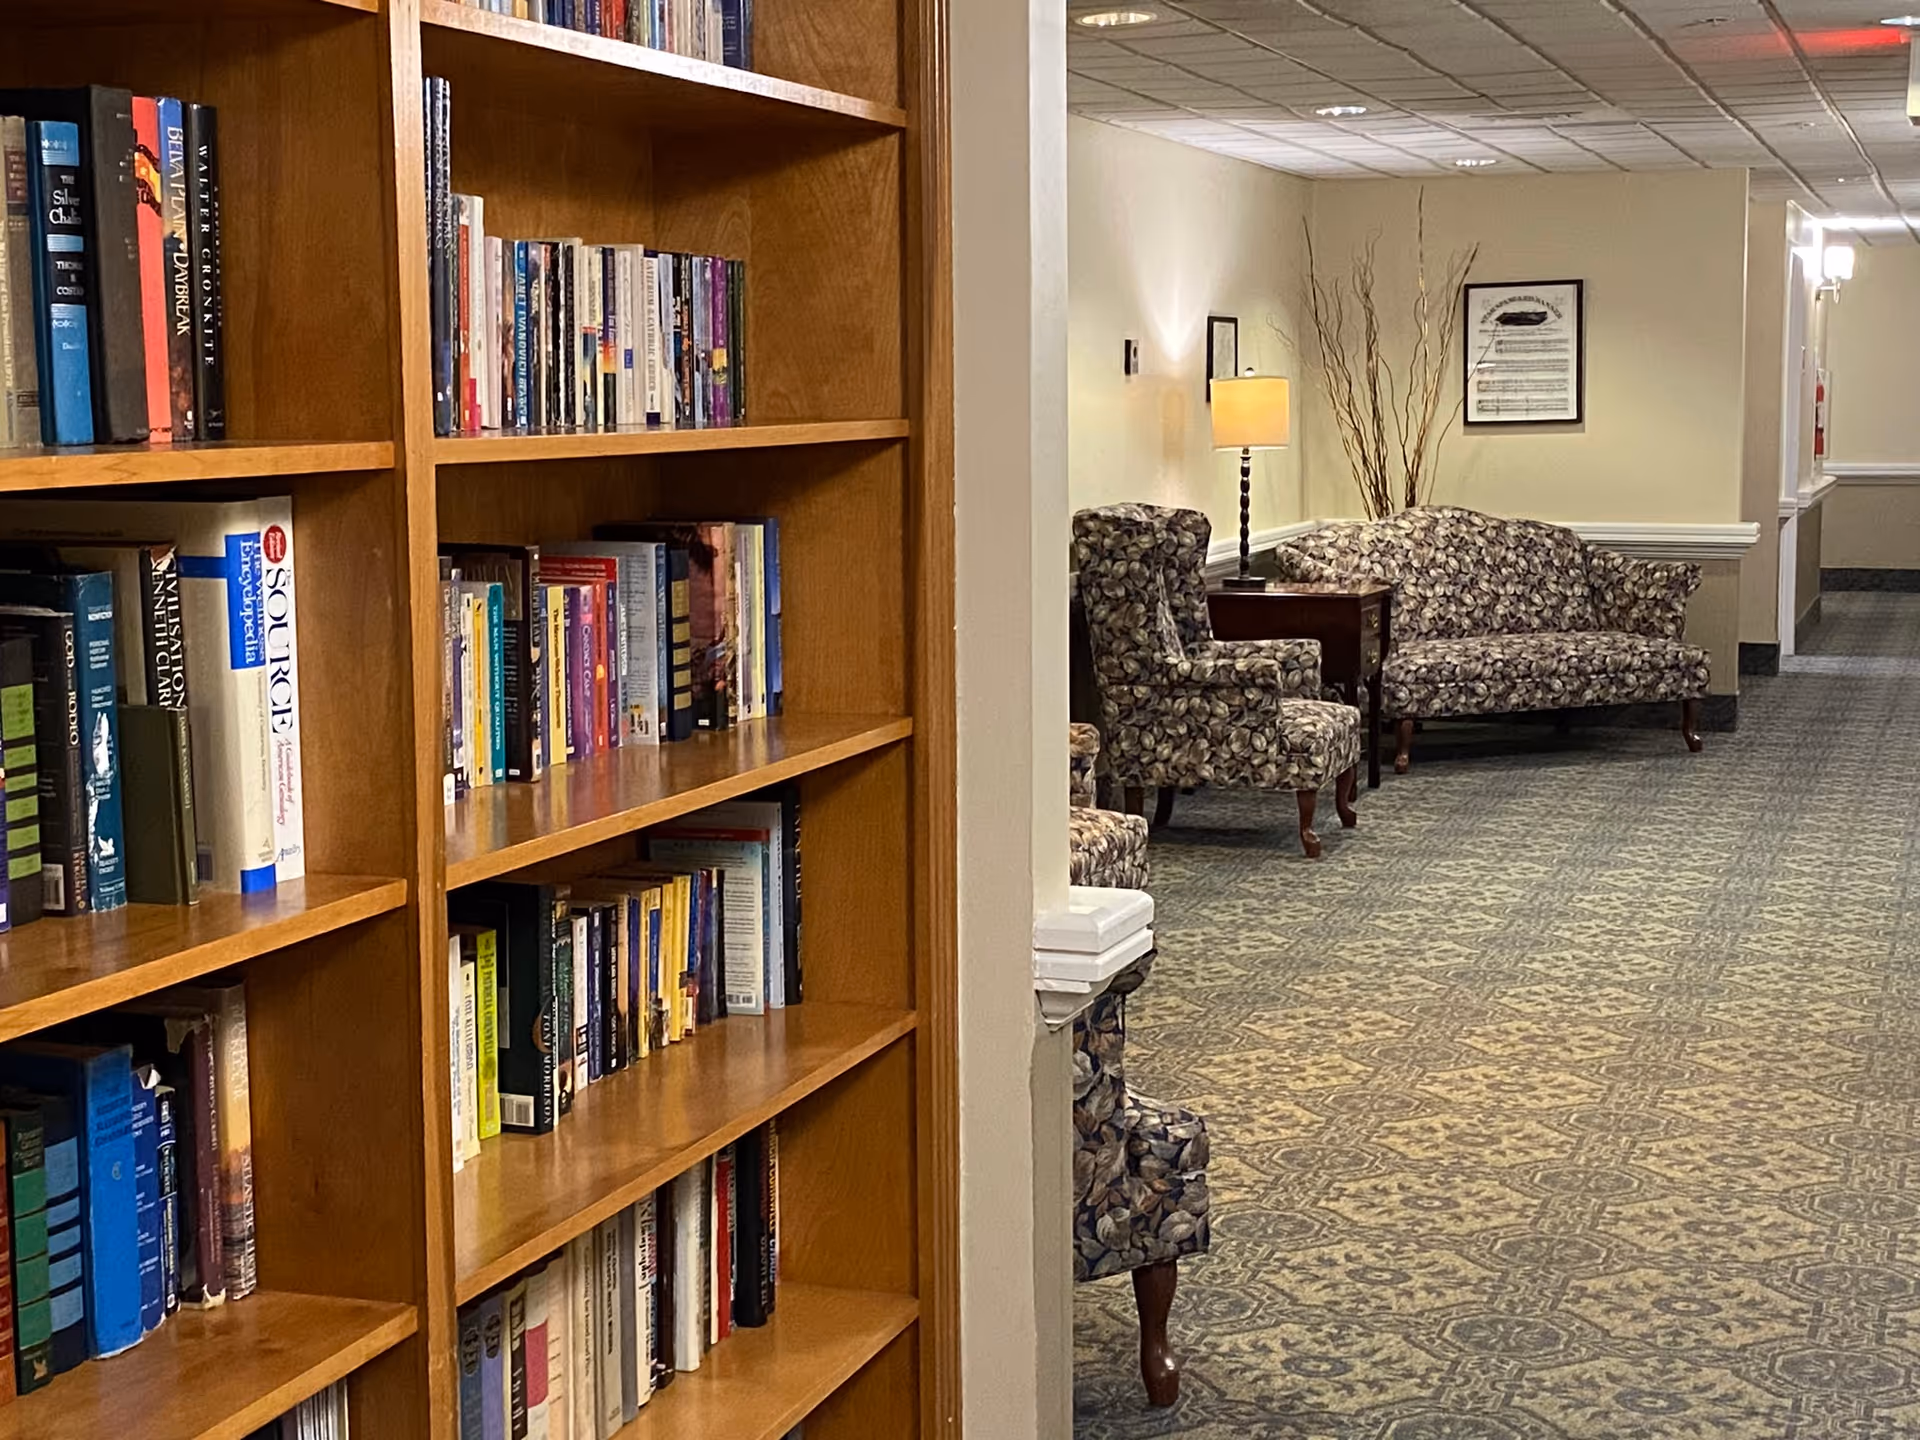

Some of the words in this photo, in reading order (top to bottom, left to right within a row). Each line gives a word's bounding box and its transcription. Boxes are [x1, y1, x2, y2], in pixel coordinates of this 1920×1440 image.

[167, 126, 184, 178] BELVA
[52, 188, 80, 205] Silver
[170, 183, 187, 239] PLAIN
[198, 144, 210, 234] WALTER
[173, 252, 191, 336] DAYBREAK
[517, 272, 527, 307] JANET
[646, 258, 655, 305] CATECHISM
[201, 248, 215, 366] CRONKITE
[2, 313, 12, 362] President
[517, 310, 528, 375] EVANOVICH
[647, 316, 656, 355] CATHOLIC
[152, 571, 170, 646] ENNETH
[239, 540, 259, 664] Encyclopedia
[531, 575, 541, 622] MURPHY'S
[552, 608, 560, 622] The
[64, 630, 76, 668] GOD
[266, 568, 293, 734] SOURCE
[532, 623, 541, 643] LAW
[553, 624, 561, 689] Merriam-Webster
[582, 625, 591, 667] CANDACE
[620, 630, 628, 676] PATTERSON
[493, 653, 501, 699] WITHOUT
[583, 669, 592, 698] CAMP
[68, 691, 80, 745] RODEO
[494, 701, 502, 750] QUALITIES
[277, 740, 286, 780] American
[285, 747, 294, 794] Guidebook
[276, 782, 287, 826] Genealogy
[286, 795, 295, 804] of
[79, 851, 87, 890] DANIEL
[483, 970, 494, 1010] PATRICIA
[465, 1018, 474, 1070] KELLERMAN
[484, 1011, 494, 1055] CORNWELL
[542, 1014, 551, 1047] TONI
[543, 1054, 552, 1124] MORRISON
[768, 1119, 777, 1166] ATRICIA
[768, 1168, 777, 1233] CORNWELL
